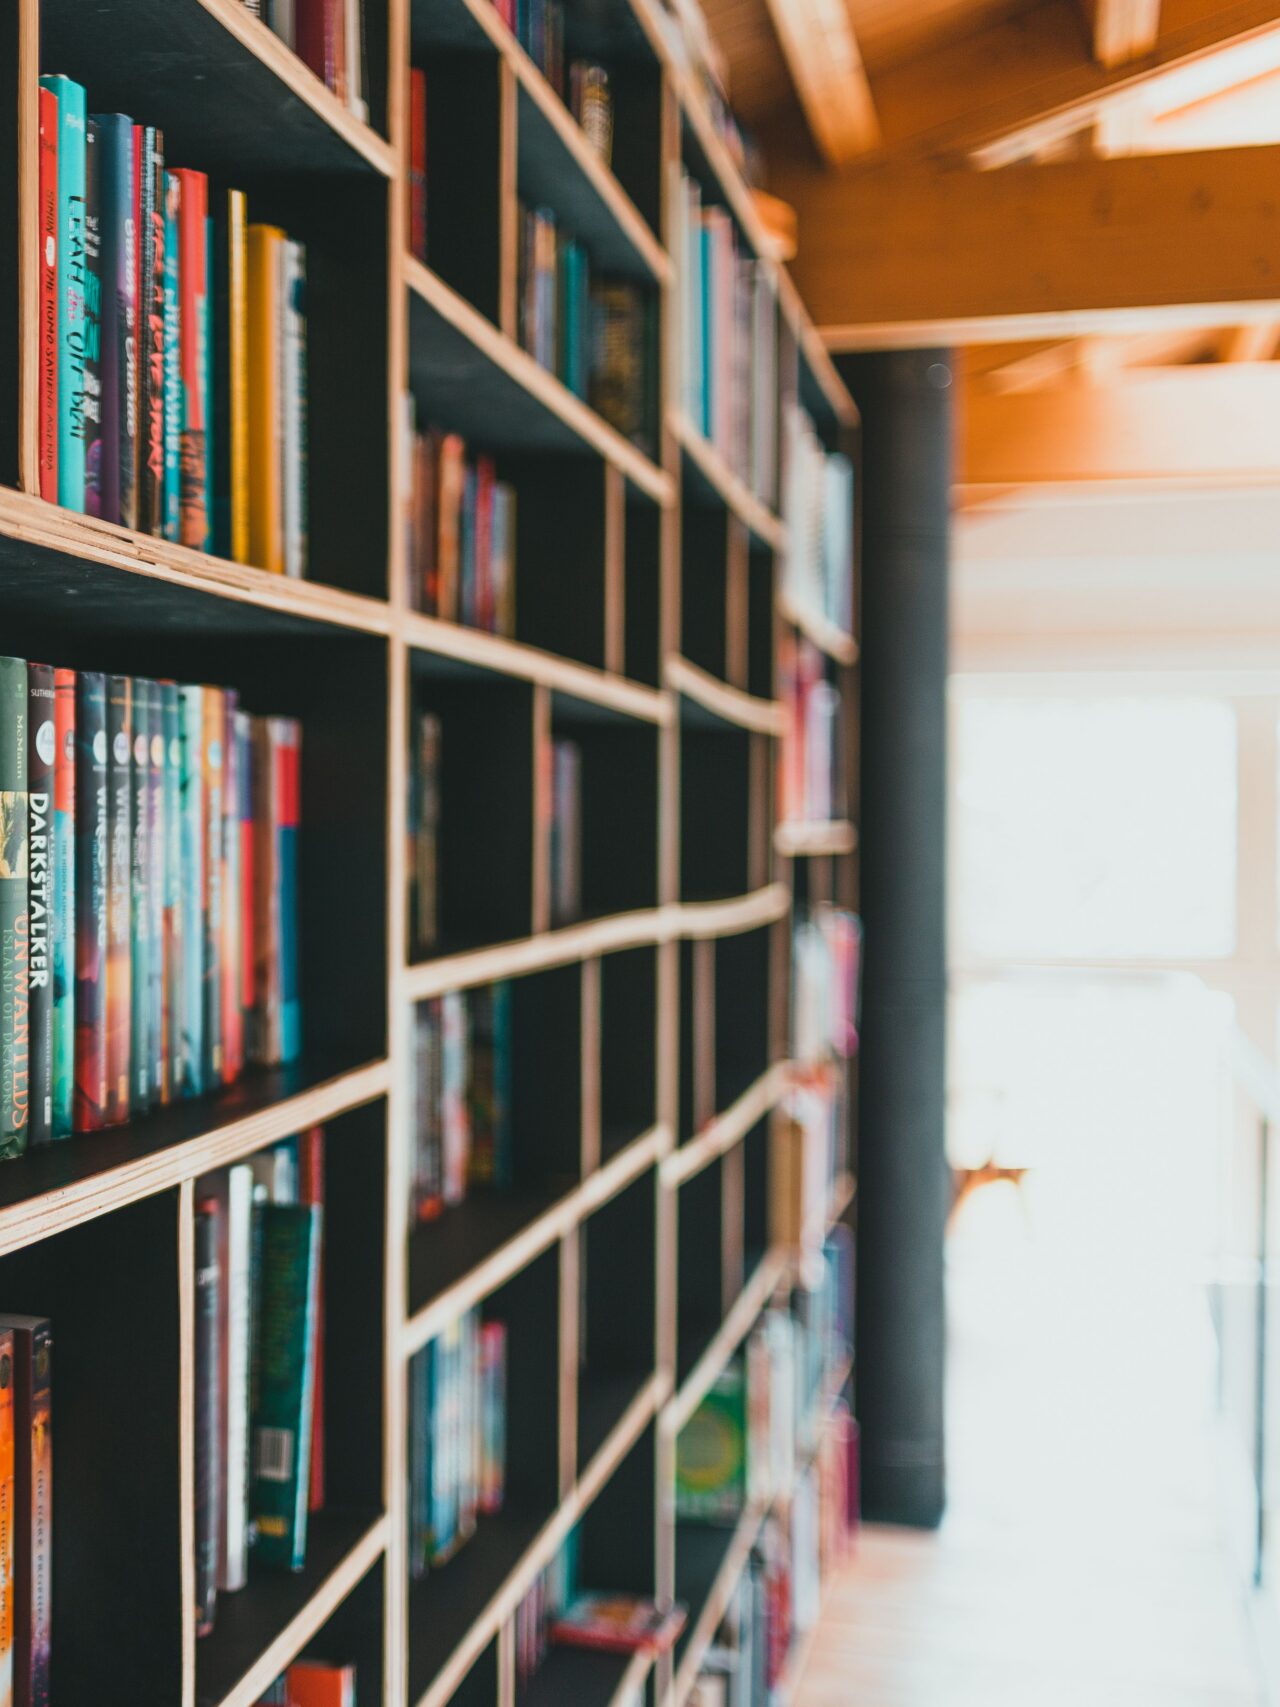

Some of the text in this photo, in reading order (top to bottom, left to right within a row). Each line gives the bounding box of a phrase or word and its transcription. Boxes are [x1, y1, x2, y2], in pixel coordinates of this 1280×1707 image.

[45, 298, 55, 343] HOMO
[16, 714, 24, 780] McMann
[29, 792, 50, 989] DARKSTALKER
[3, 928, 14, 1115] ISLAND OF DRAGONS
[12, 914, 28, 1130] UNWANTEDS
